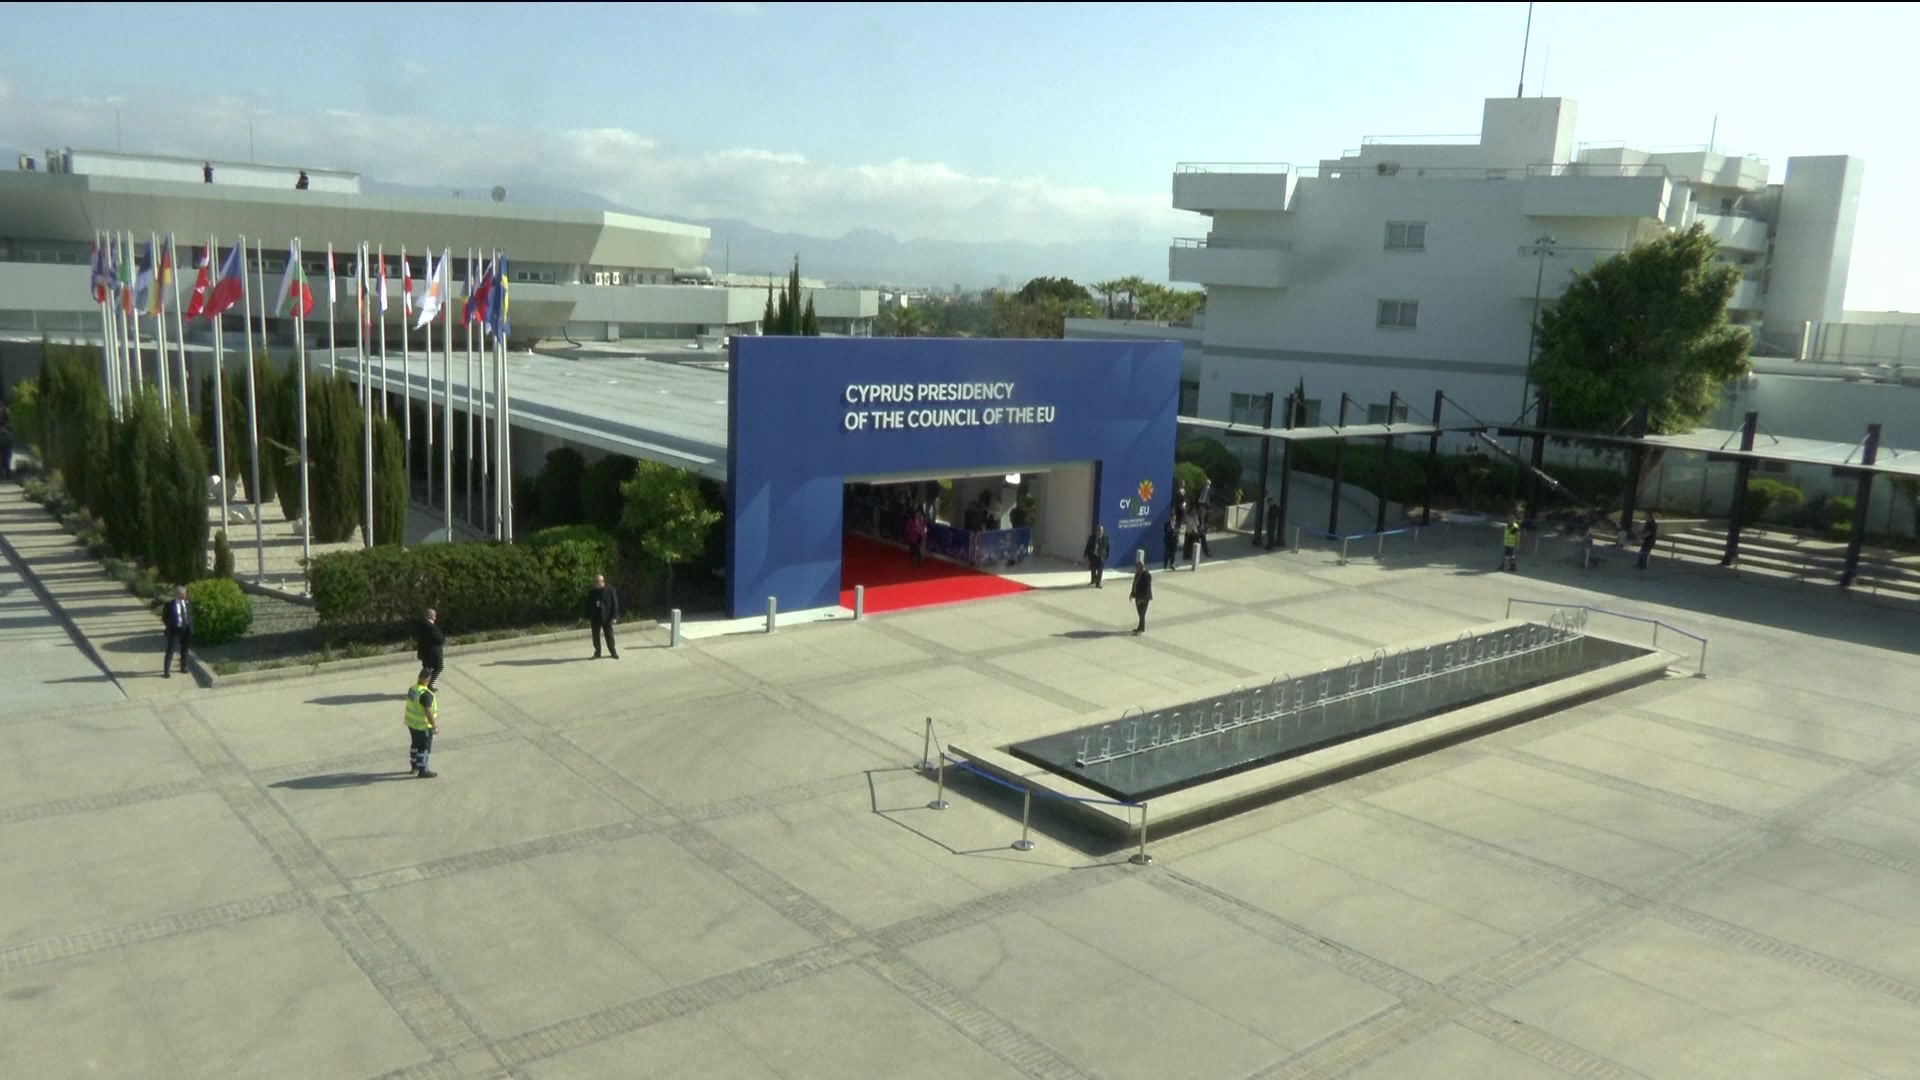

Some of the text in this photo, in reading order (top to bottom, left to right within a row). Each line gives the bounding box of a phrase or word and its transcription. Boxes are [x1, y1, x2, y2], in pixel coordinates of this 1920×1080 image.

[845, 382, 1014, 403] CYPRUS PRESIDENCY
[844, 406, 1055, 430] OF THE COUNCIL OF THE EU
[1119, 498, 1131, 509] CY
